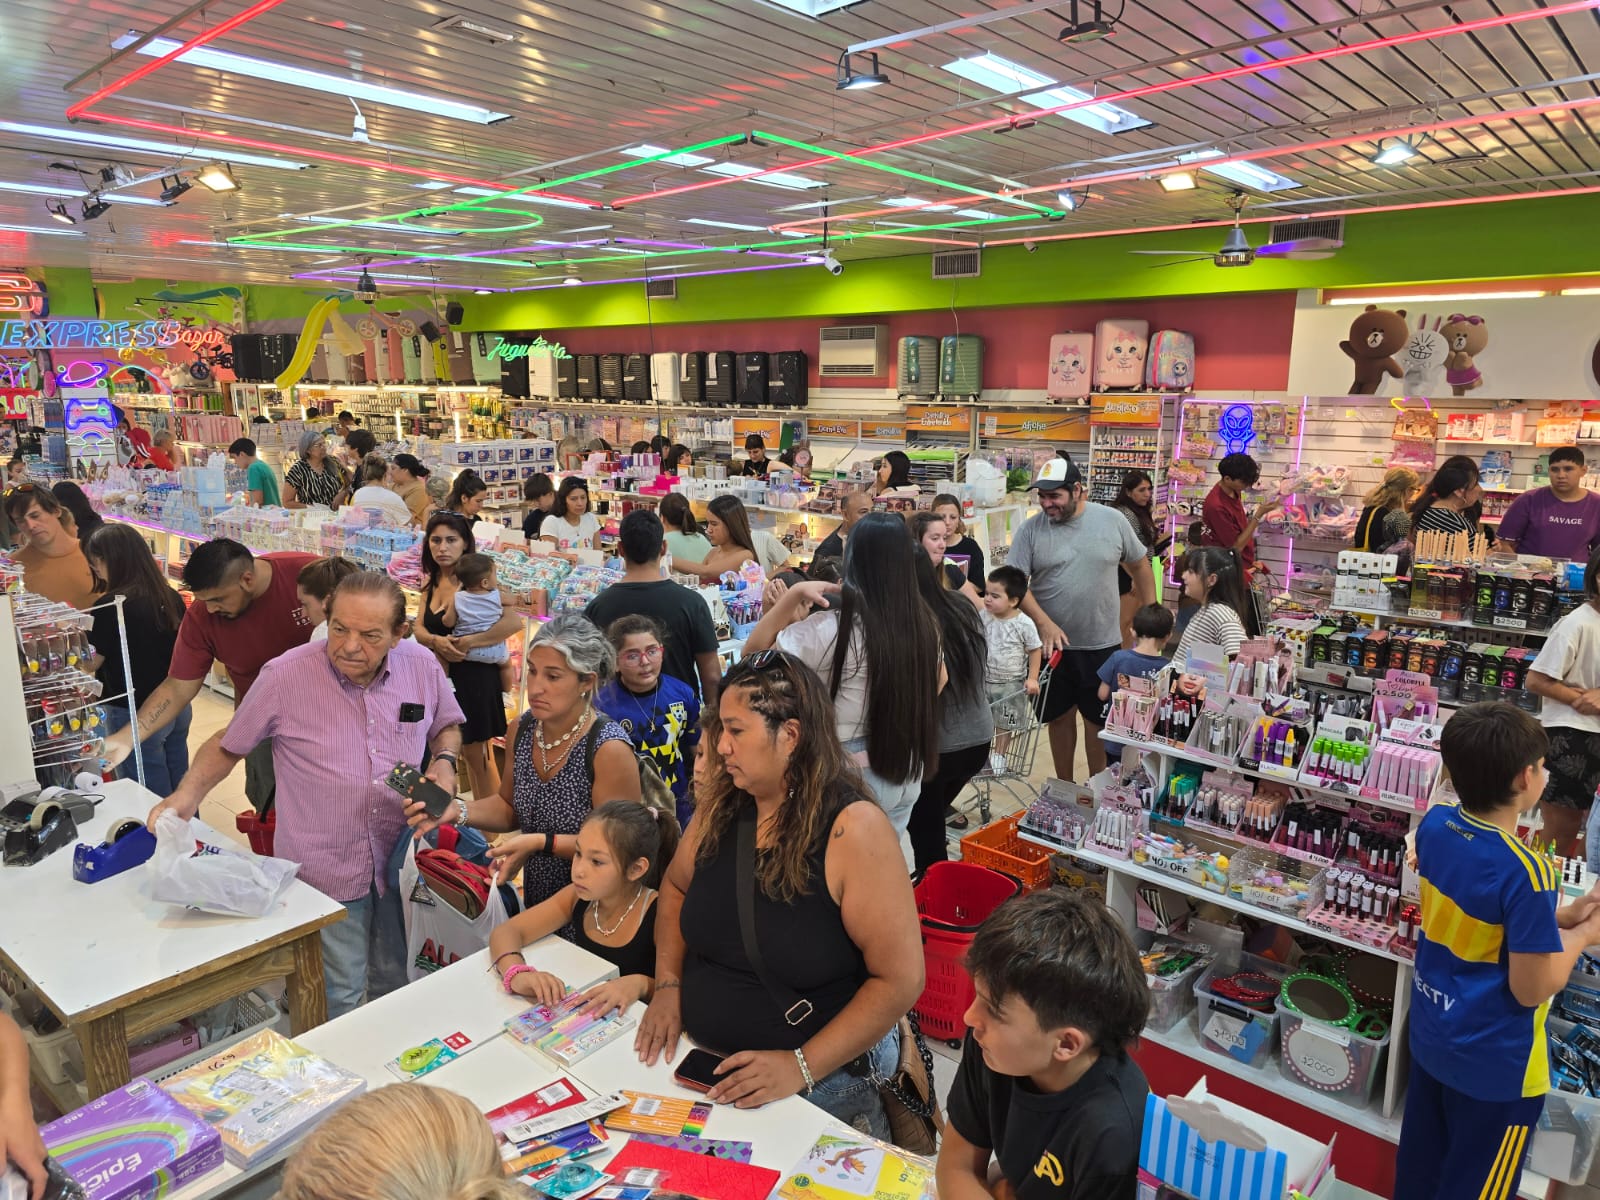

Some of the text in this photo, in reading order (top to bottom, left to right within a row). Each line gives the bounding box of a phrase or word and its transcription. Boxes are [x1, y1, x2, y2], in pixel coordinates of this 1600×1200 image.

[1, 320, 178, 348] EXPRESS
[159, 321, 226, 351] Bazar
[1549, 515, 1582, 525] SAVAGE
[1170, 862, 1188, 874] OFF
[419, 938, 460, 967] AL
[1414, 970, 1456, 1012] ECTV
